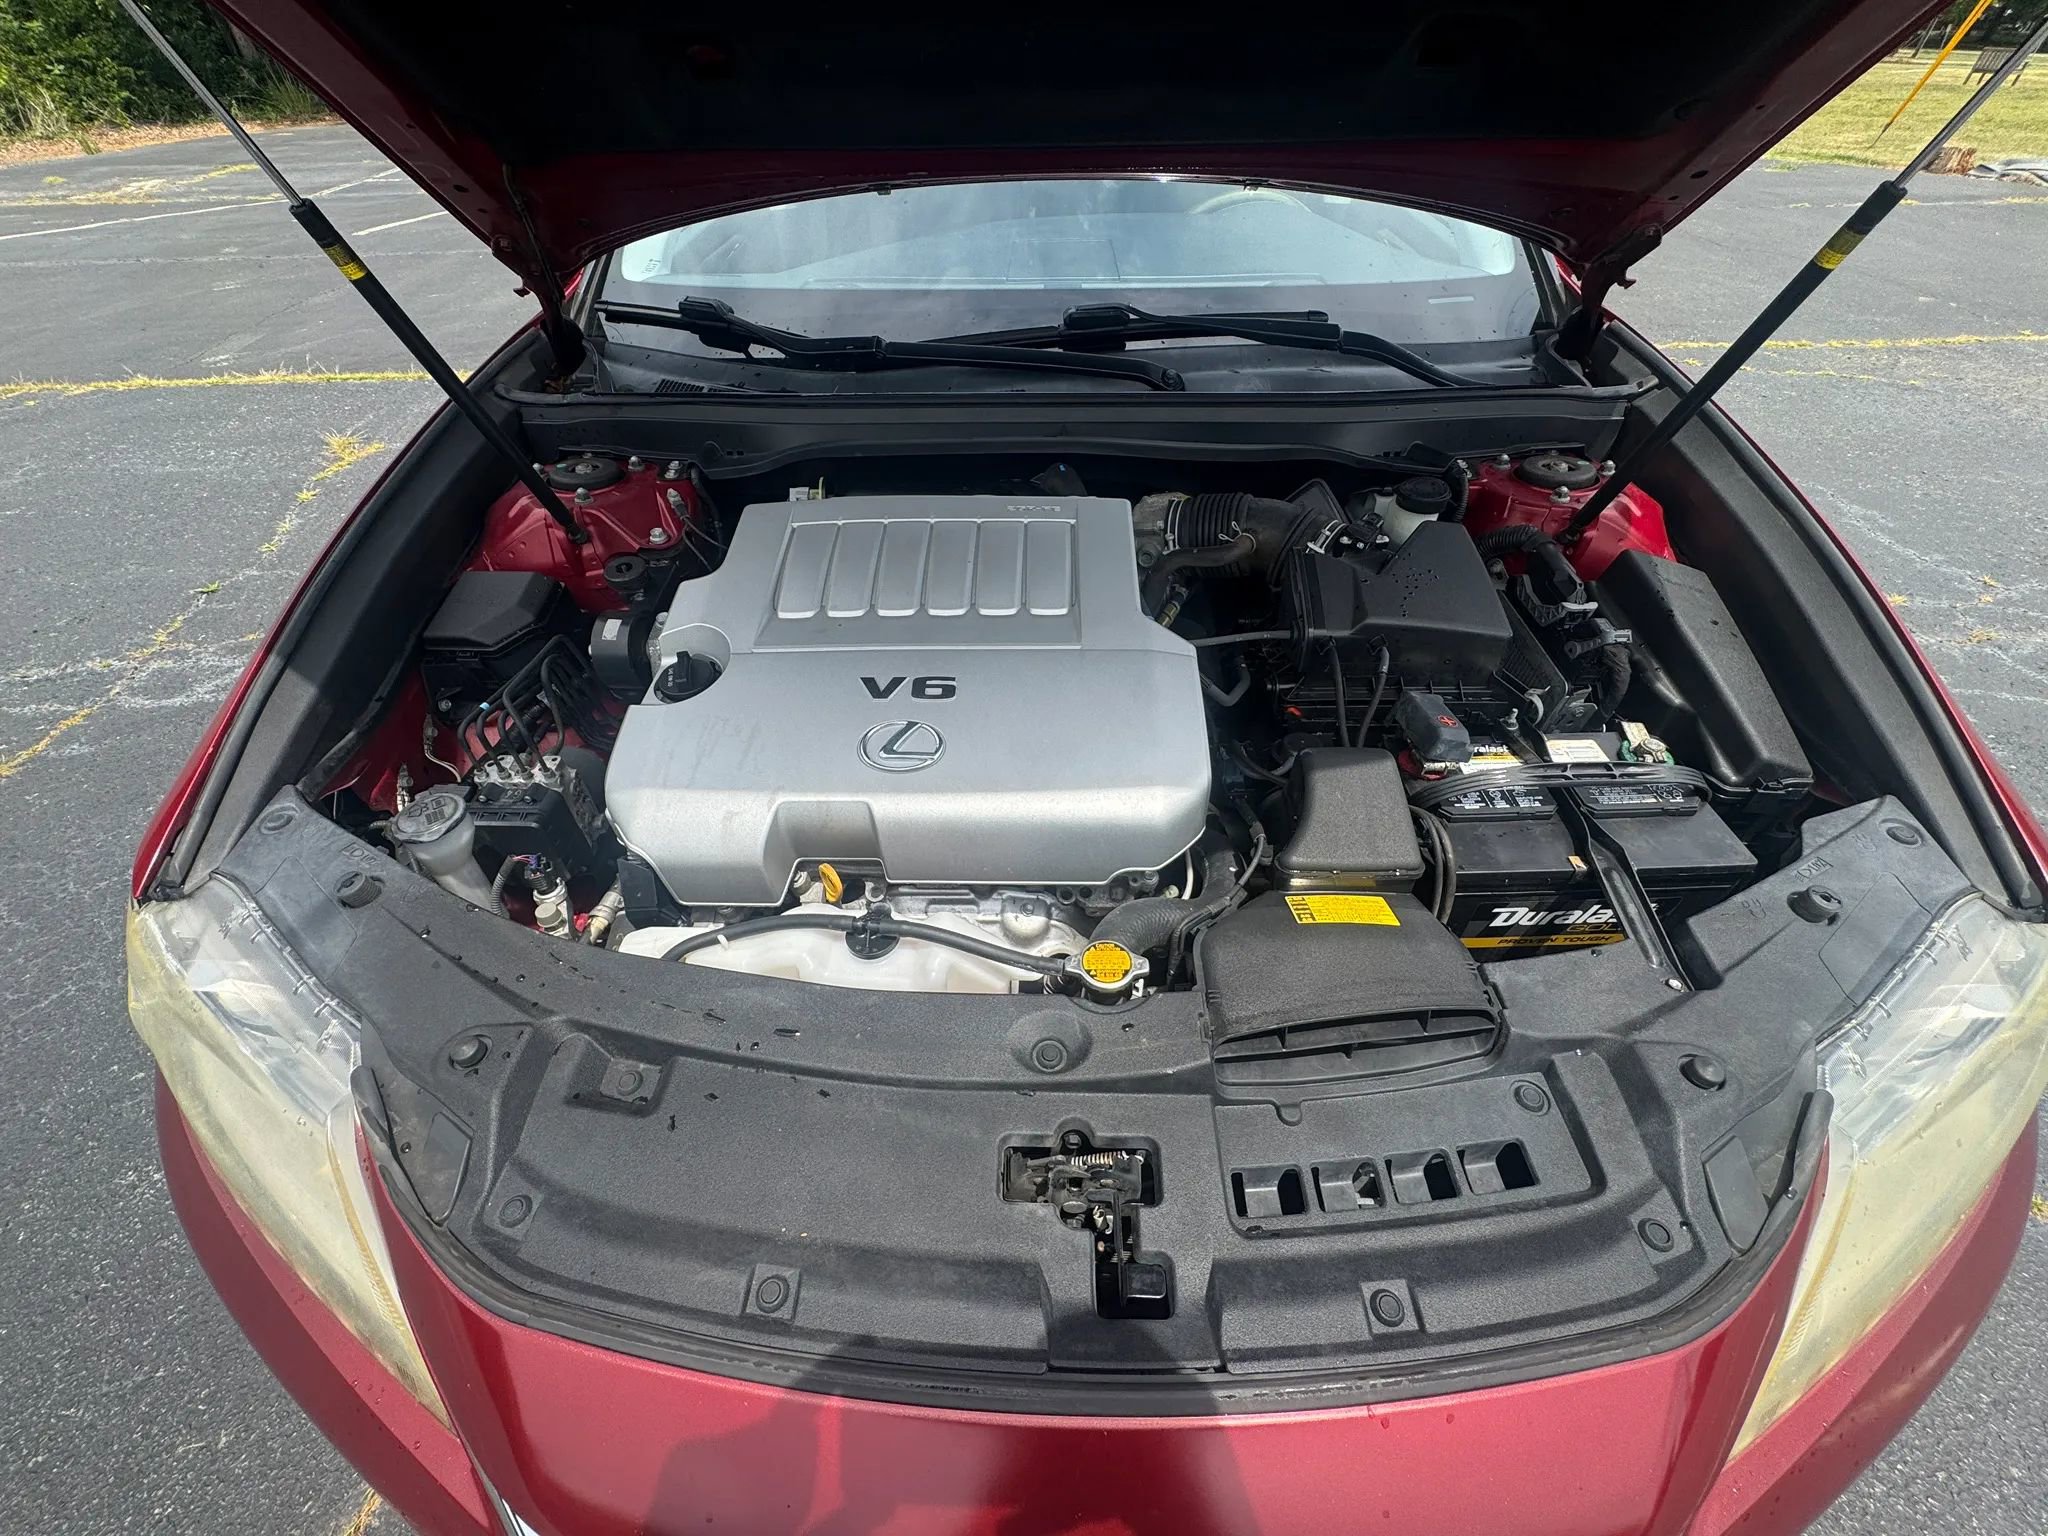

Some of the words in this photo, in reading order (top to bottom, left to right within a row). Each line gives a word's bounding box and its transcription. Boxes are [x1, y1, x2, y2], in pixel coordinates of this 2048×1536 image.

[860, 675, 957, 701] V6
[1474, 744, 1509, 753] ralast
[1489, 903, 1659, 927] Durala
[1566, 923, 1622, 932] GOL
[1497, 936, 1559, 945] PROVEN
[1563, 935, 1613, 943] TOUGH
